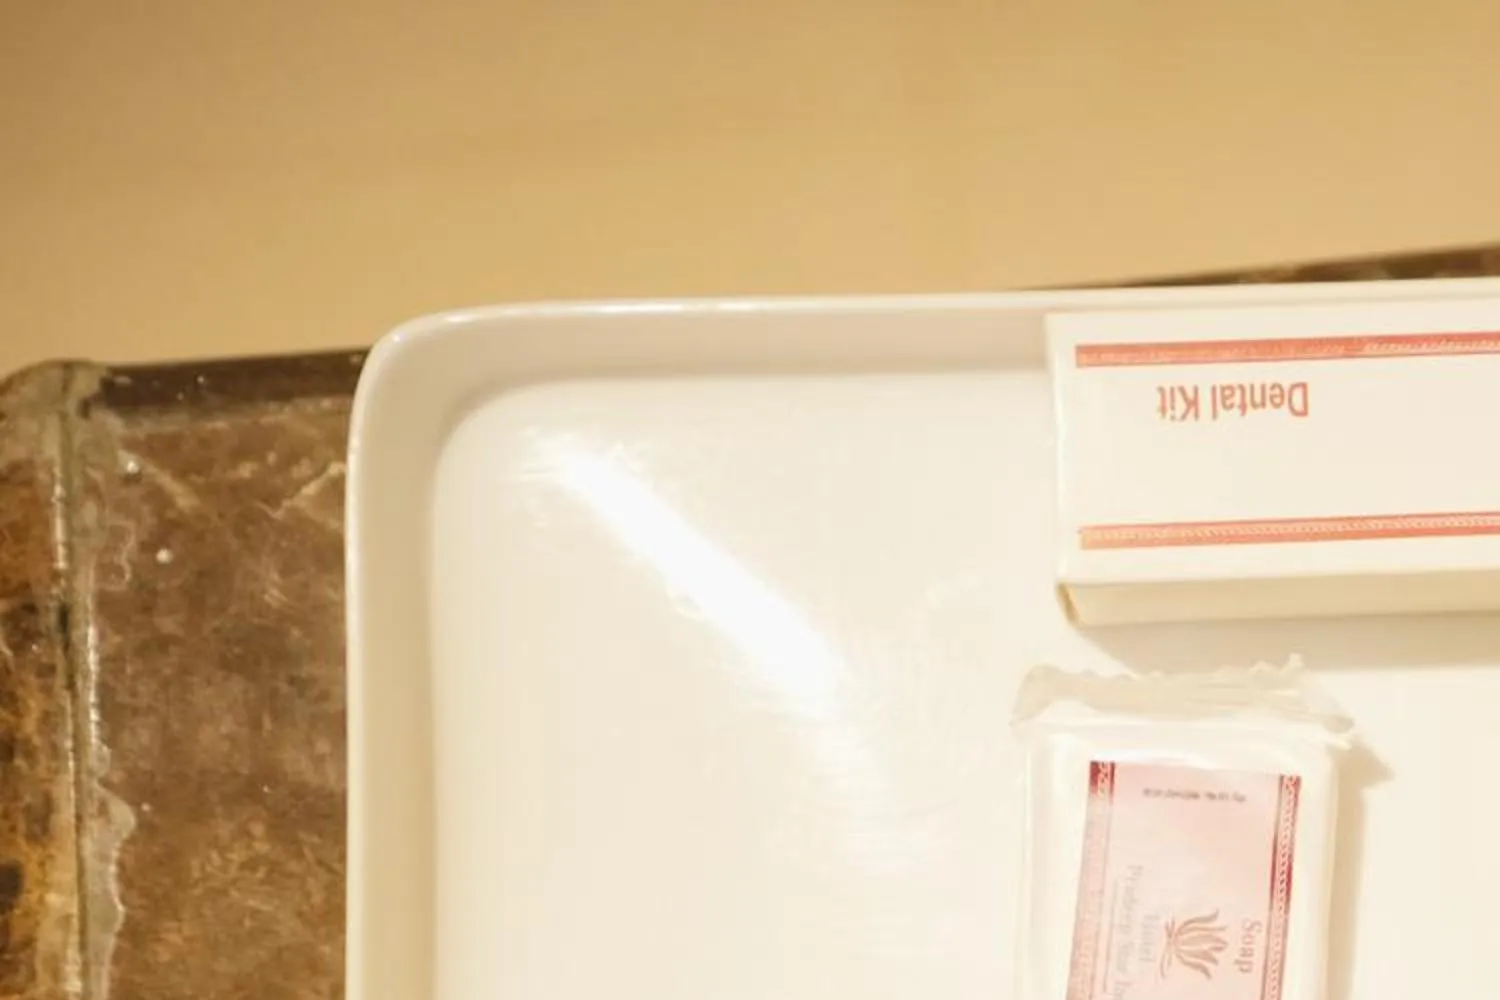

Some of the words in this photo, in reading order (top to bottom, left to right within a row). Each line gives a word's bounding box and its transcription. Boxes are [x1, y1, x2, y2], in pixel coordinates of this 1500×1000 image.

[1156, 385, 1199, 423] Kit
[1211, 382, 1308, 421] Dental
[1232, 918, 1263, 974] Soap
